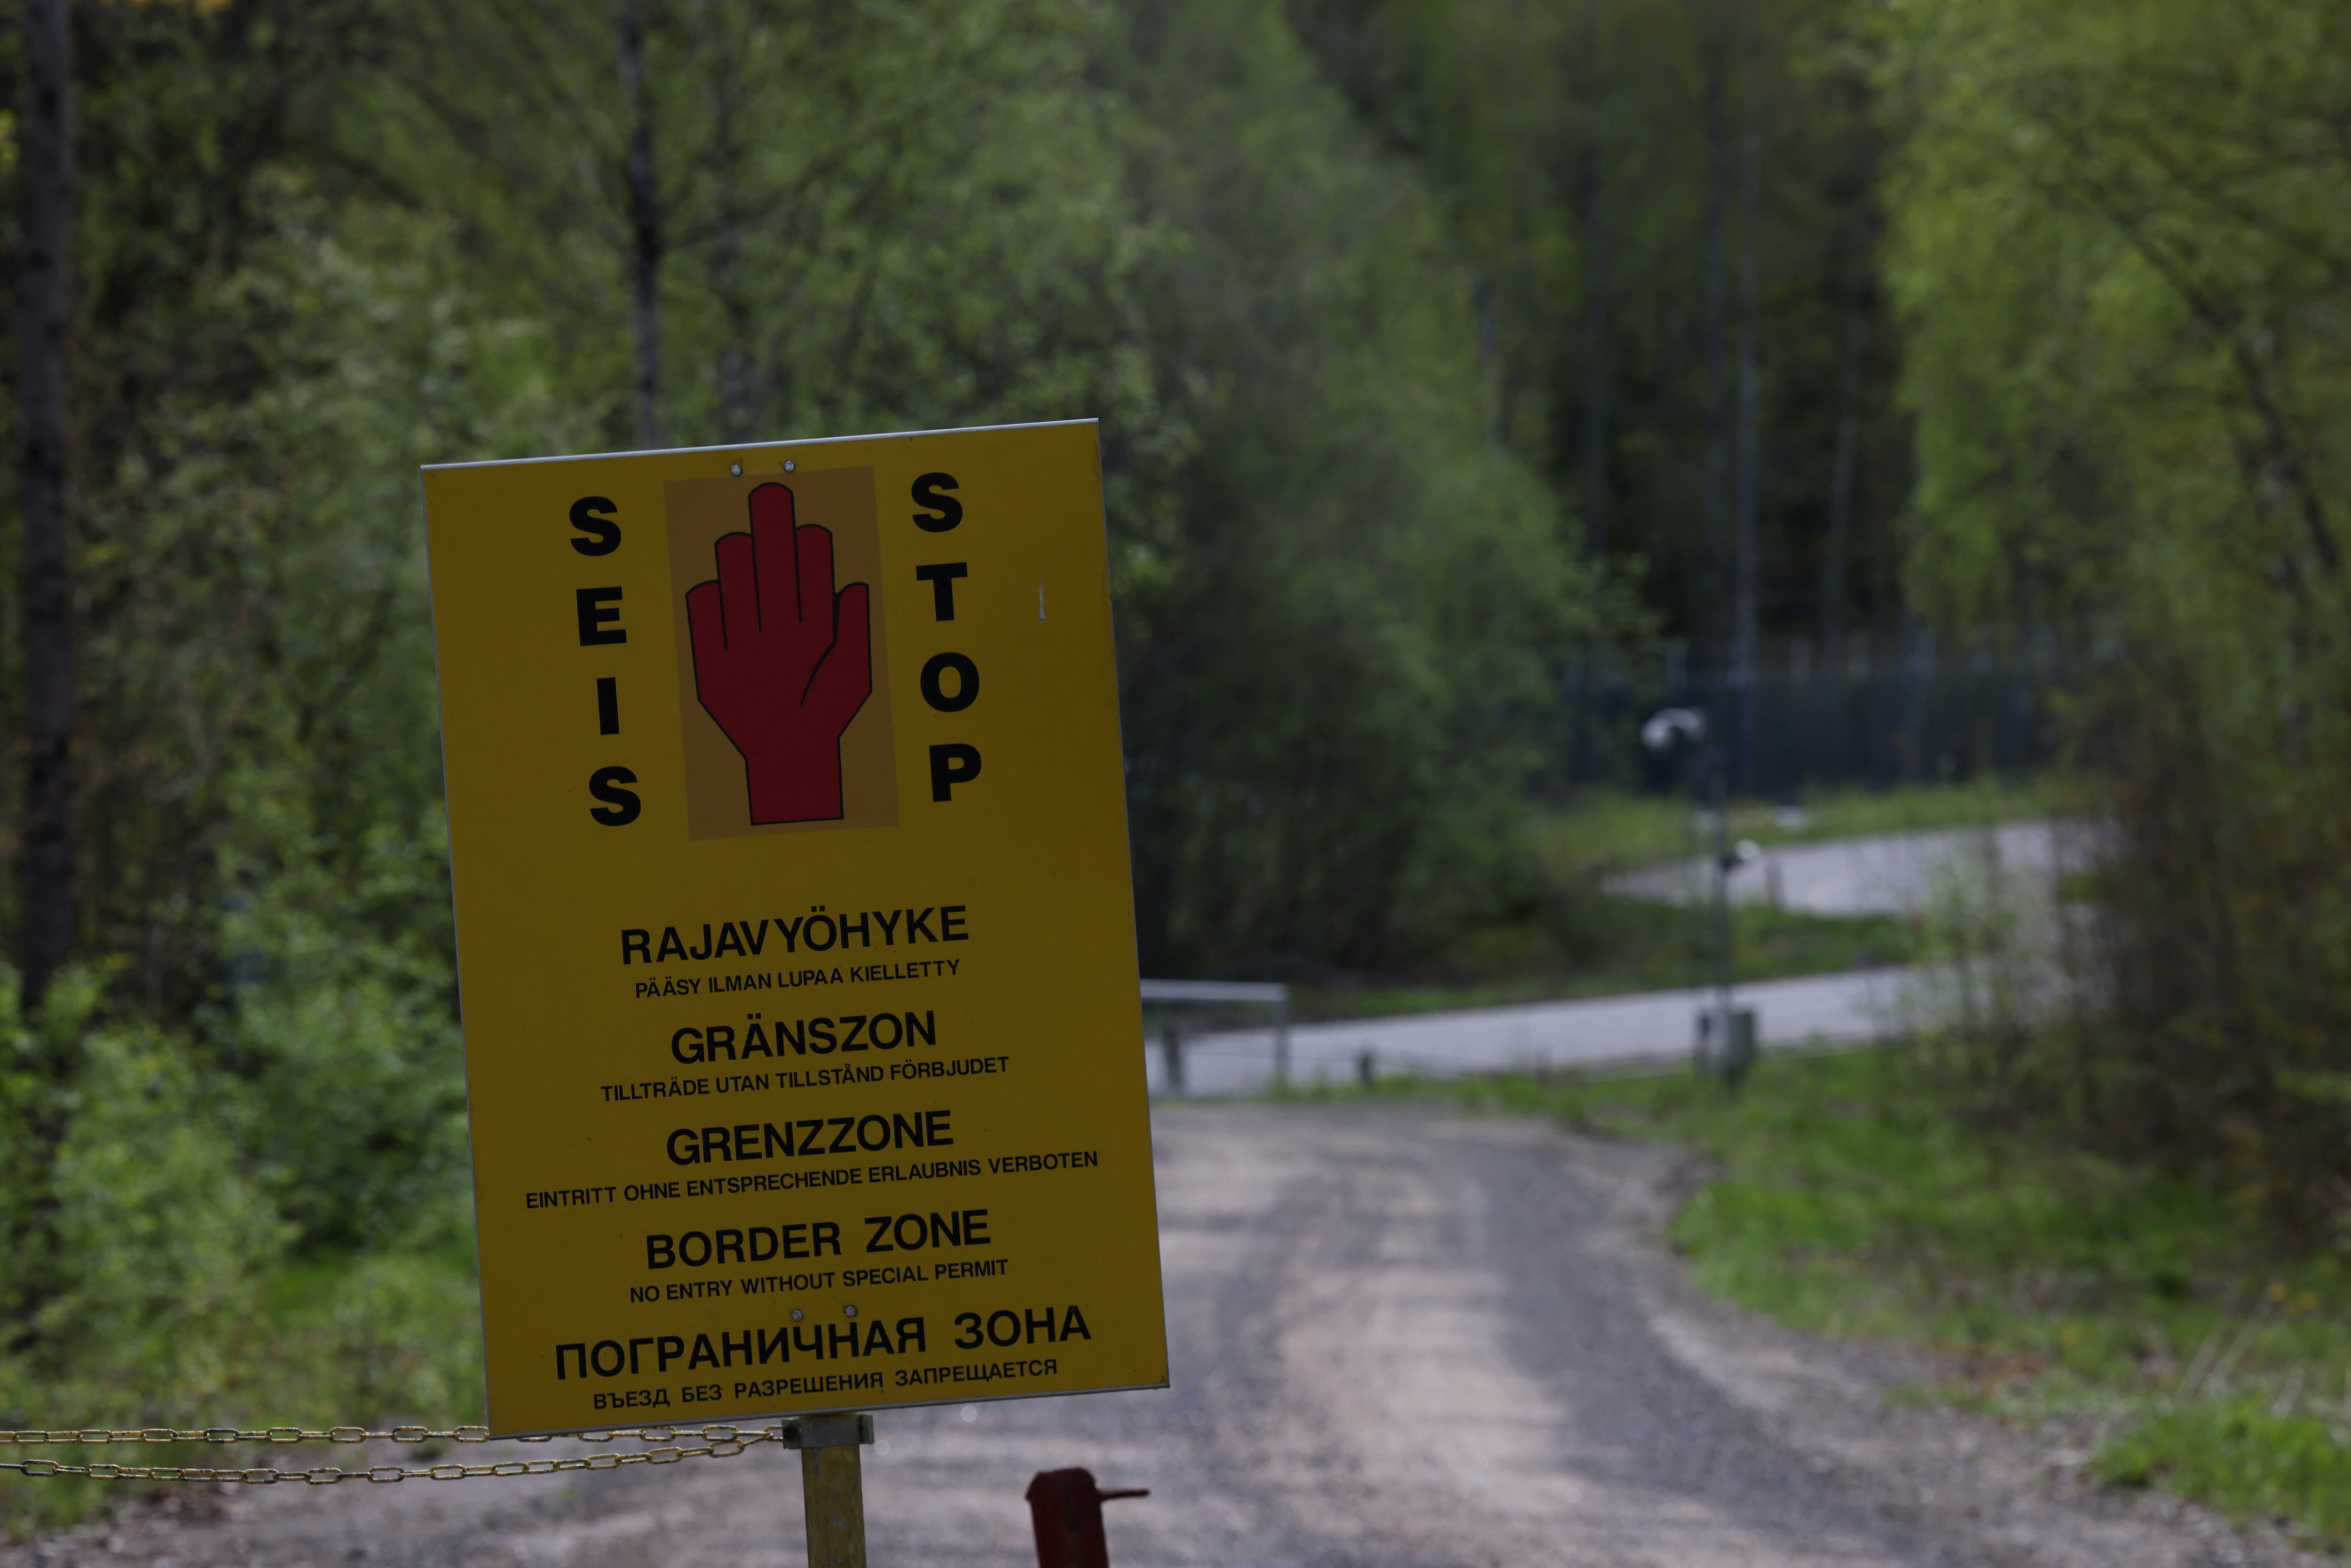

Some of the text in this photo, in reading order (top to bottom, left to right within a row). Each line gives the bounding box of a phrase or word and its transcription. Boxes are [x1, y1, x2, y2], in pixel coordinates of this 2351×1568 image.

[568, 496, 642, 827] SEIS
[910, 472, 983, 803] STOP
[621, 904, 970, 966] RAJAVYÖHYKE
[635, 958, 960, 999] PÄÄSY ILMAN LUPAA KIELLETTY
[671, 1009, 937, 1065] GRÄNSZON
[600, 1056, 1010, 1102] TILLTRÄDE UTAN TILLSTÅND FÖRBJUDET
[666, 1109, 955, 1166] GRENZZONE
[526, 1150, 1098, 1209] EINTRITT OHNE ENTSPRECHENDE ERLAUBNIS VERBOTEN
[646, 1208, 992, 1270] BORDER ZONE
[630, 1258, 1009, 1304] NO ENTRY WITHOUT SPECIAL PERMIT
[555, 1305, 1092, 1381] ПОГРАНИЧНАЯ ЗОНА
[593, 1358, 1058, 1410] ВЪЕЗД БЕЗ РАЗРЕШЕНИЯ ЗАПРЕЩАЕТСЯ
